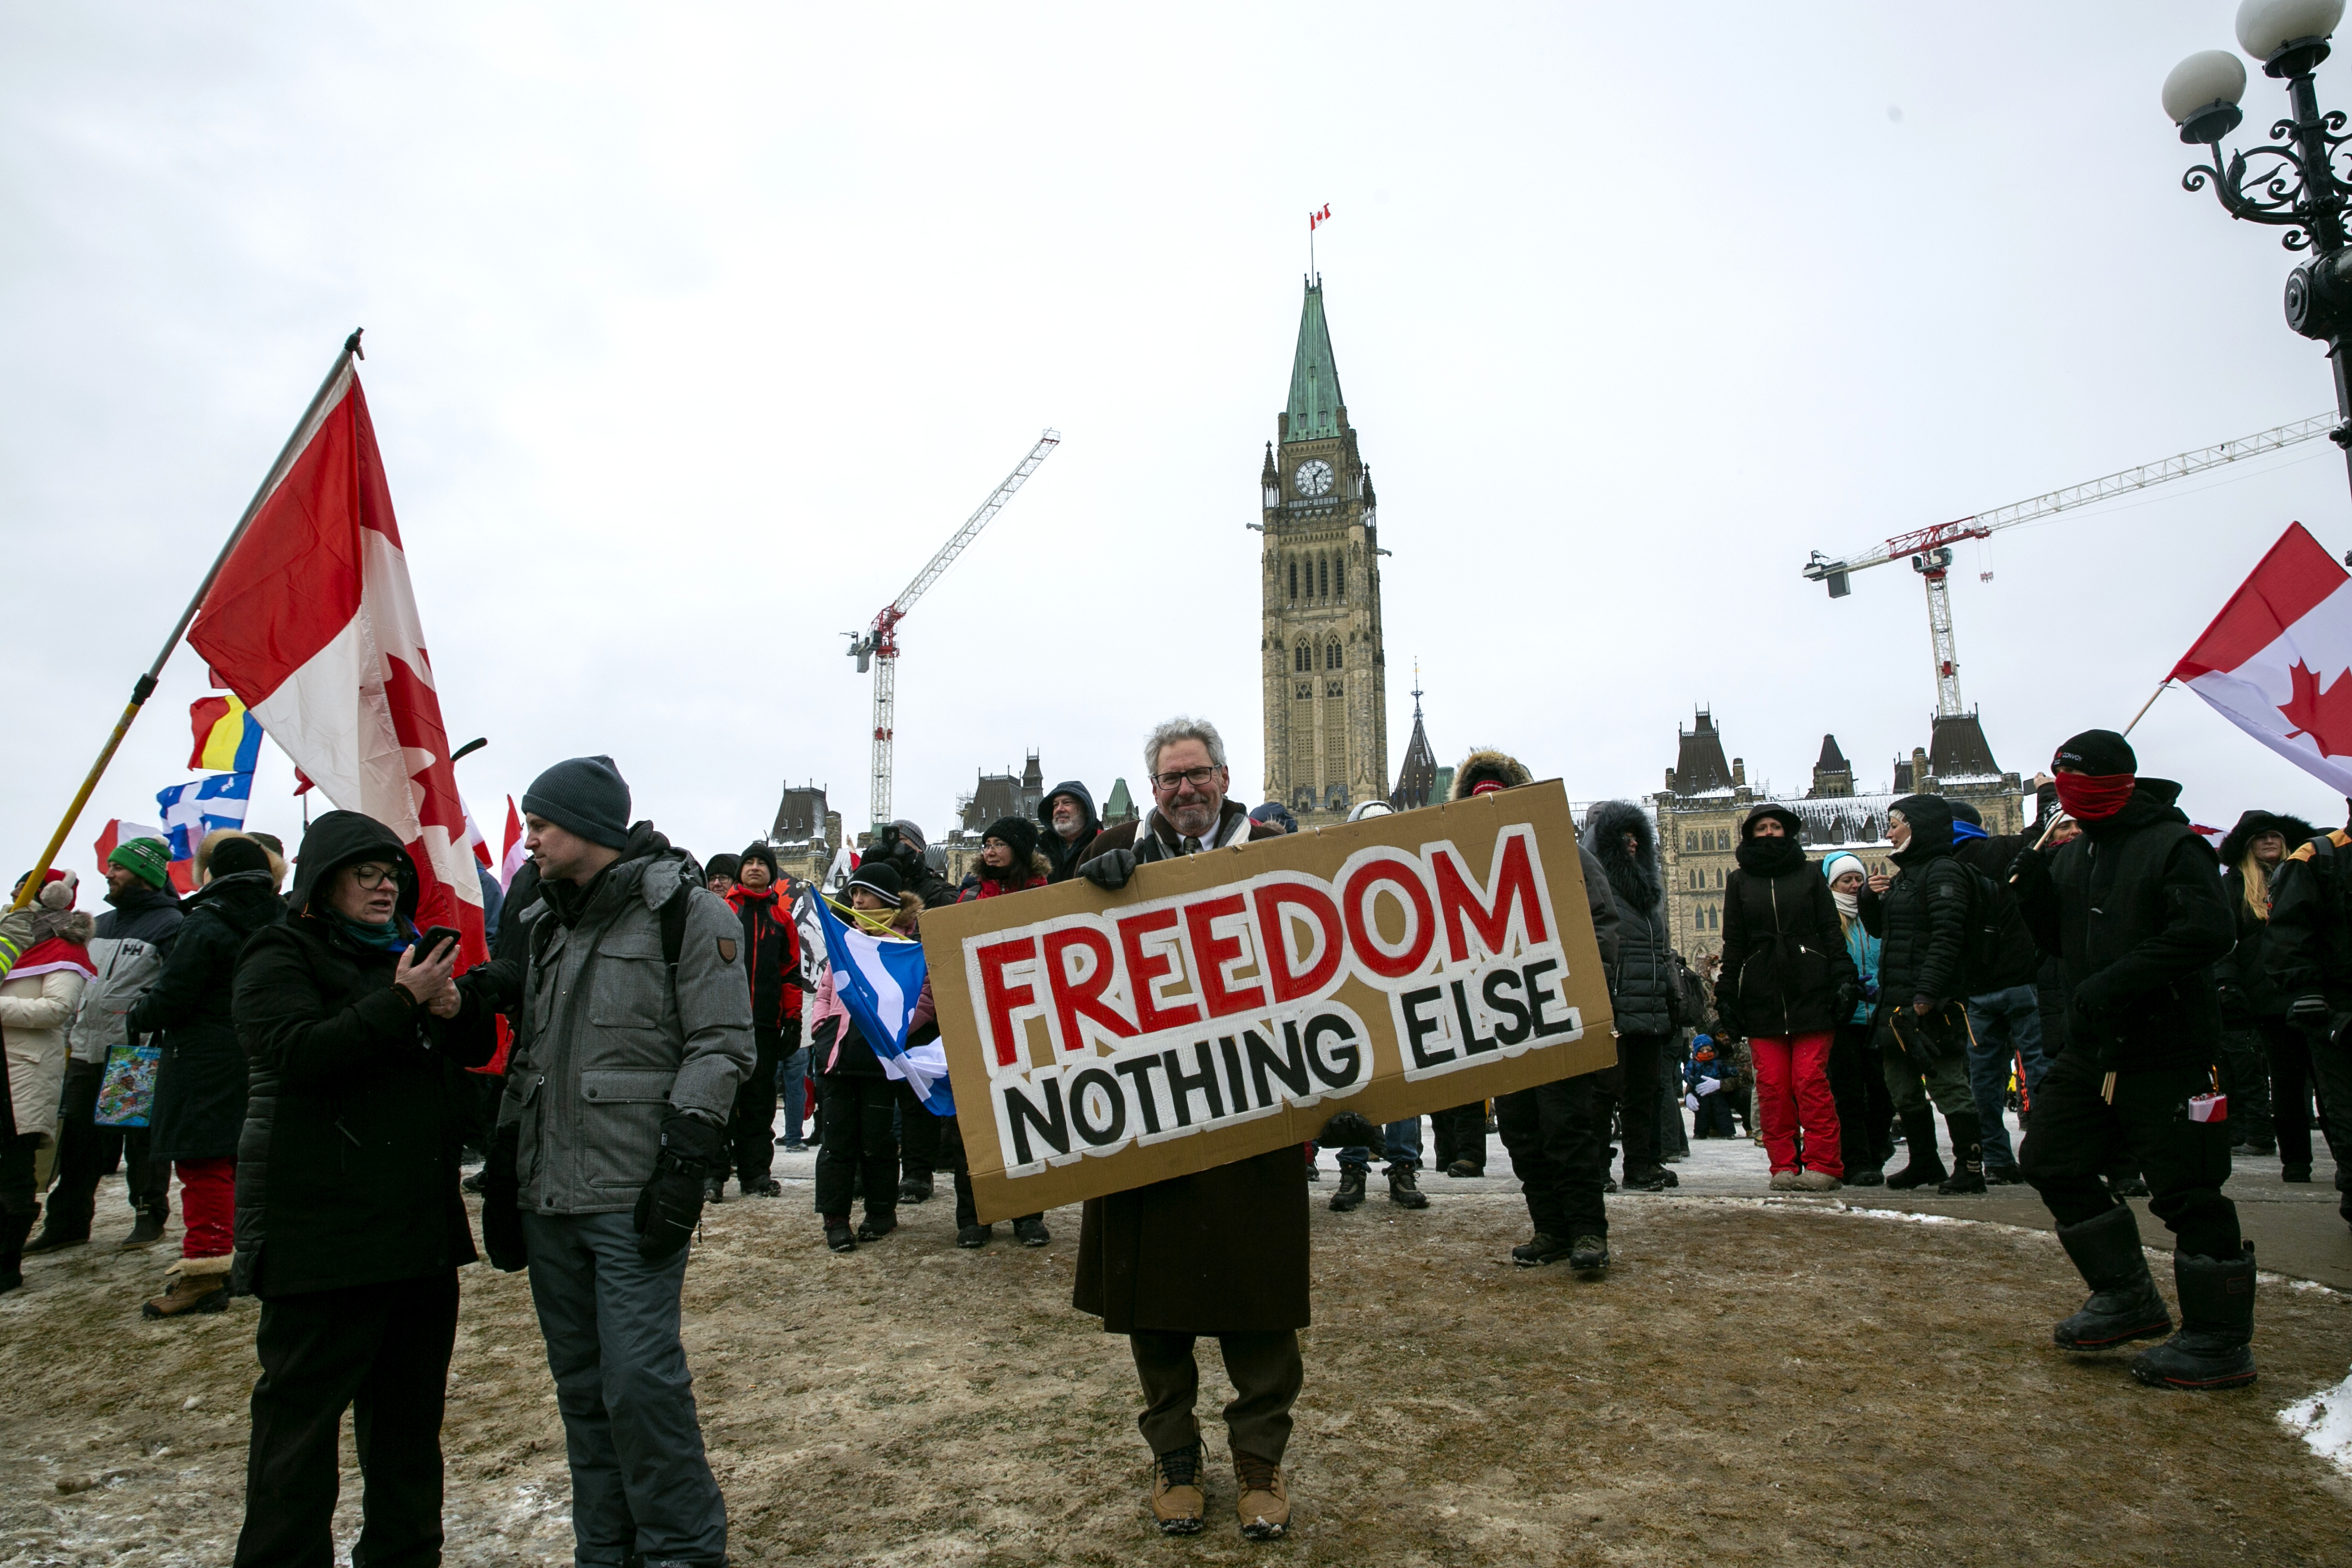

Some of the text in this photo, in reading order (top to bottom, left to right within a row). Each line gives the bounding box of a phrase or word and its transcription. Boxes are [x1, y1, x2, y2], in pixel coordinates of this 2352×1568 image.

[2062, 752, 2082, 761] CONVOY
[121, 944, 144, 956] HH
[976, 834, 1548, 1066] FREEDOM
[1004, 958, 1575, 1165] NOTHING ELSE
